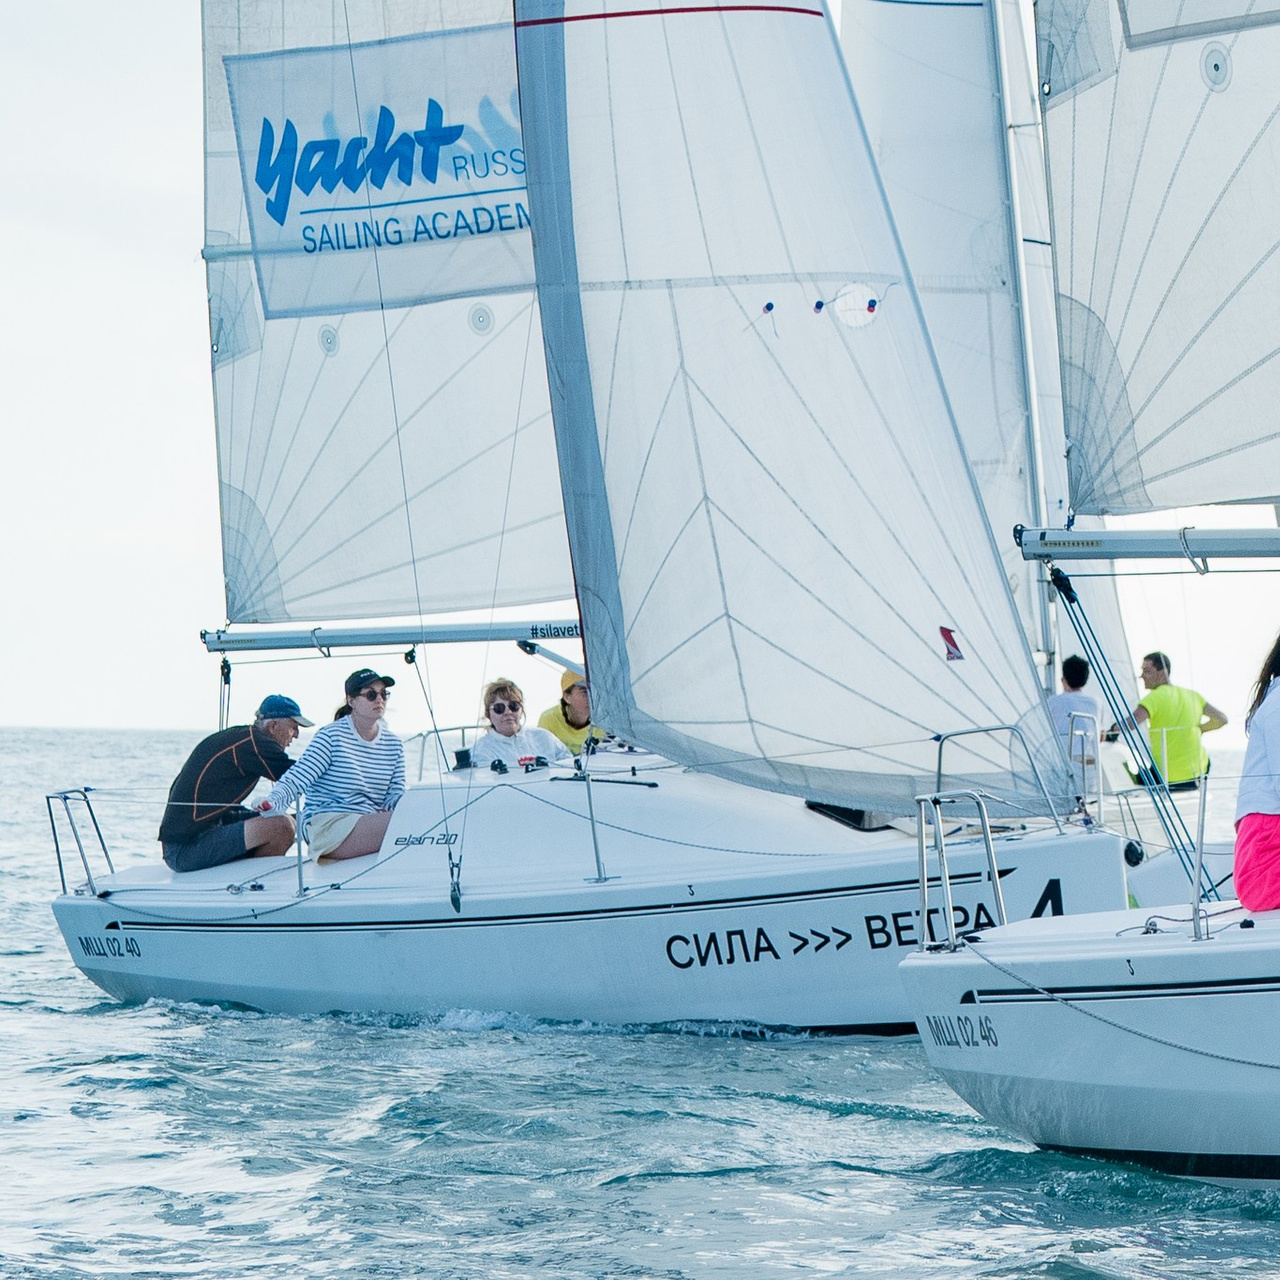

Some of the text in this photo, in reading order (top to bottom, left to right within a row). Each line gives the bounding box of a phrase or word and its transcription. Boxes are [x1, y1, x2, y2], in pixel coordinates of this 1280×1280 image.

[302, 217, 404, 253] SAILING
[105, 937, 125, 957] 02
[125, 937, 141, 957] 40
[666, 927, 781, 970] СИЛА
[956, 1015, 980, 1047] 02
[979, 1015, 998, 1047] 46
